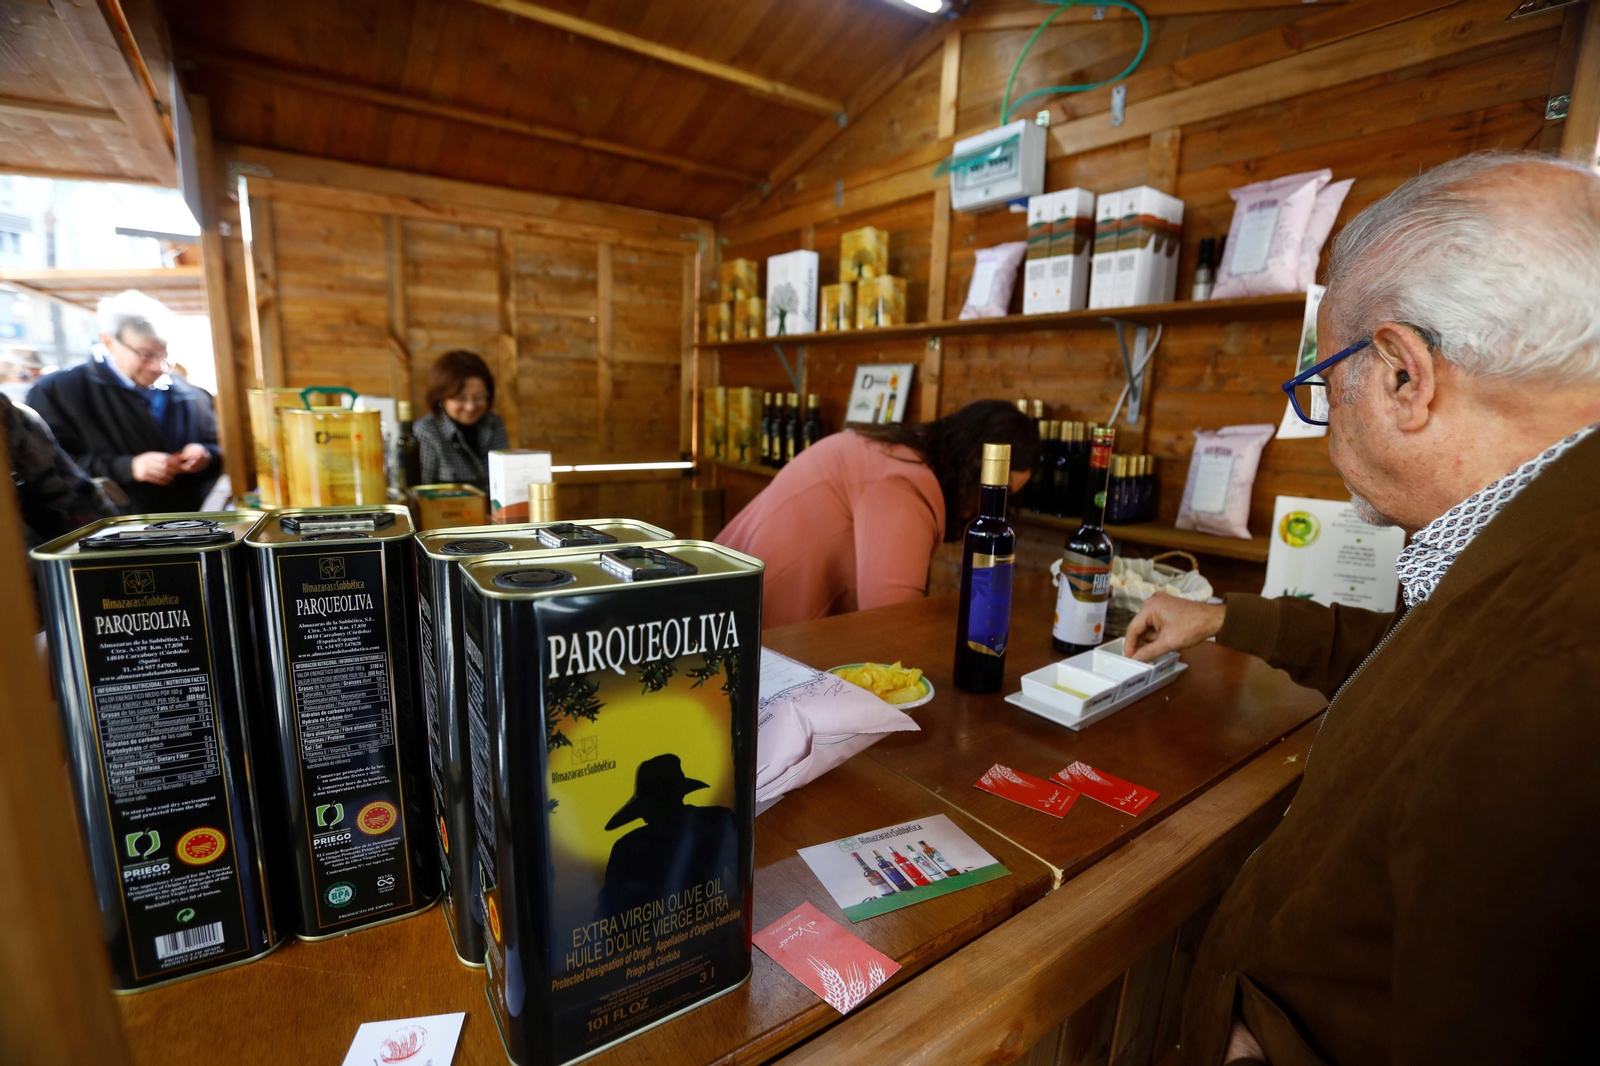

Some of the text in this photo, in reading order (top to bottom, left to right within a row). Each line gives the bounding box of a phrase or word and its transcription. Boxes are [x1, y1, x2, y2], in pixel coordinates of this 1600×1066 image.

[296, 594, 373, 617] PARQUEOLIVA
[95, 610, 191, 636] PARQUEOLIVA
[548, 611, 739, 679] PARQUEOLIVA
[97, 683, 131, 694] INFORMACIÓN
[132, 681, 163, 690] NUTRICIONAL
[181, 796, 216, 805] environment
[142, 809, 169, 819] protected
[313, 833, 351, 846] PRIEGO
[124, 863, 170, 878] PRIEGO
[332, 889, 350, 900] BPA
[339, 909, 367, 919] PRODUCTO
[573, 878, 723, 947] EXTRA VIRGIN OLIVE OIL
[566, 894, 729, 971] HUILE D'OLIVE VIERGE EXTRA
[779, 920, 819, 948] el Vacar
[552, 971, 584, 992] Protected
[586, 956, 624, 981] Designation
[625, 952, 633, 964] of
[633, 946, 651, 963] Origin
[656, 932, 688, 952] Appellation
[689, 921, 714, 939] d'Origine
[626, 950, 681, 980] Priego de Córdoba
[699, 971, 707, 983] 3
[586, 998, 650, 1032] 101 FL OZ
